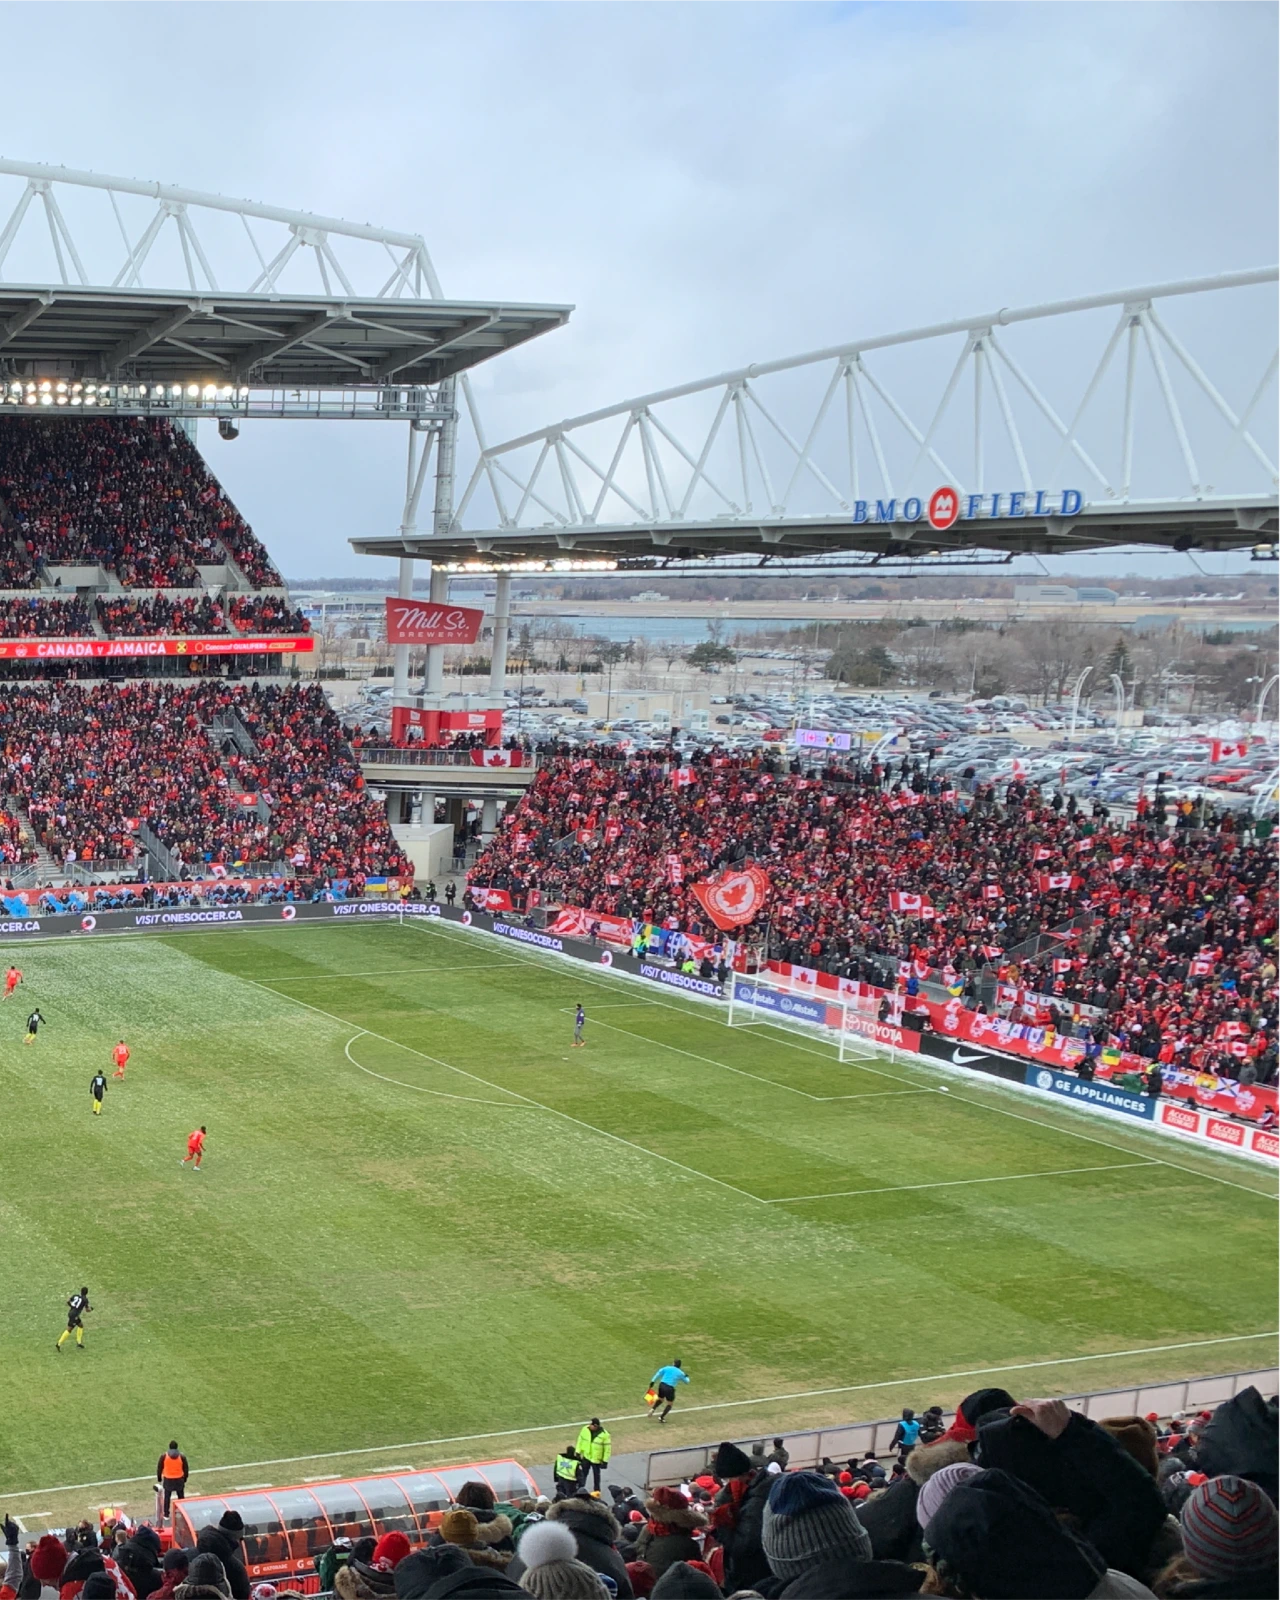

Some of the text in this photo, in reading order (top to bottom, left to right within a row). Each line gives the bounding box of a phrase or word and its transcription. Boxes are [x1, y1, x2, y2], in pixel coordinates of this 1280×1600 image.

[853, 489, 1083, 523] BMO FIELD
[393, 607, 470, 630] Mill St.
[37, 642, 167, 656] CANADA v JAMAICA
[233, 642, 267, 650] QUALIFIERS
[333, 902, 441, 915] VISIT ONESOCCER.CA
[135, 910, 243, 925] VISIT ONESOCCER.CA
[493, 922, 563, 950] VISIT ONESOCCER.CA
[640, 963, 661, 979] VISIT
[860, 1022, 904, 1044] TOYOTA
[1055, 1080, 1146, 1113] GE APPLIANCES
[1167, 1109, 1197, 1123] ACCESS
[1212, 1122, 1241, 1137] ACCESS
